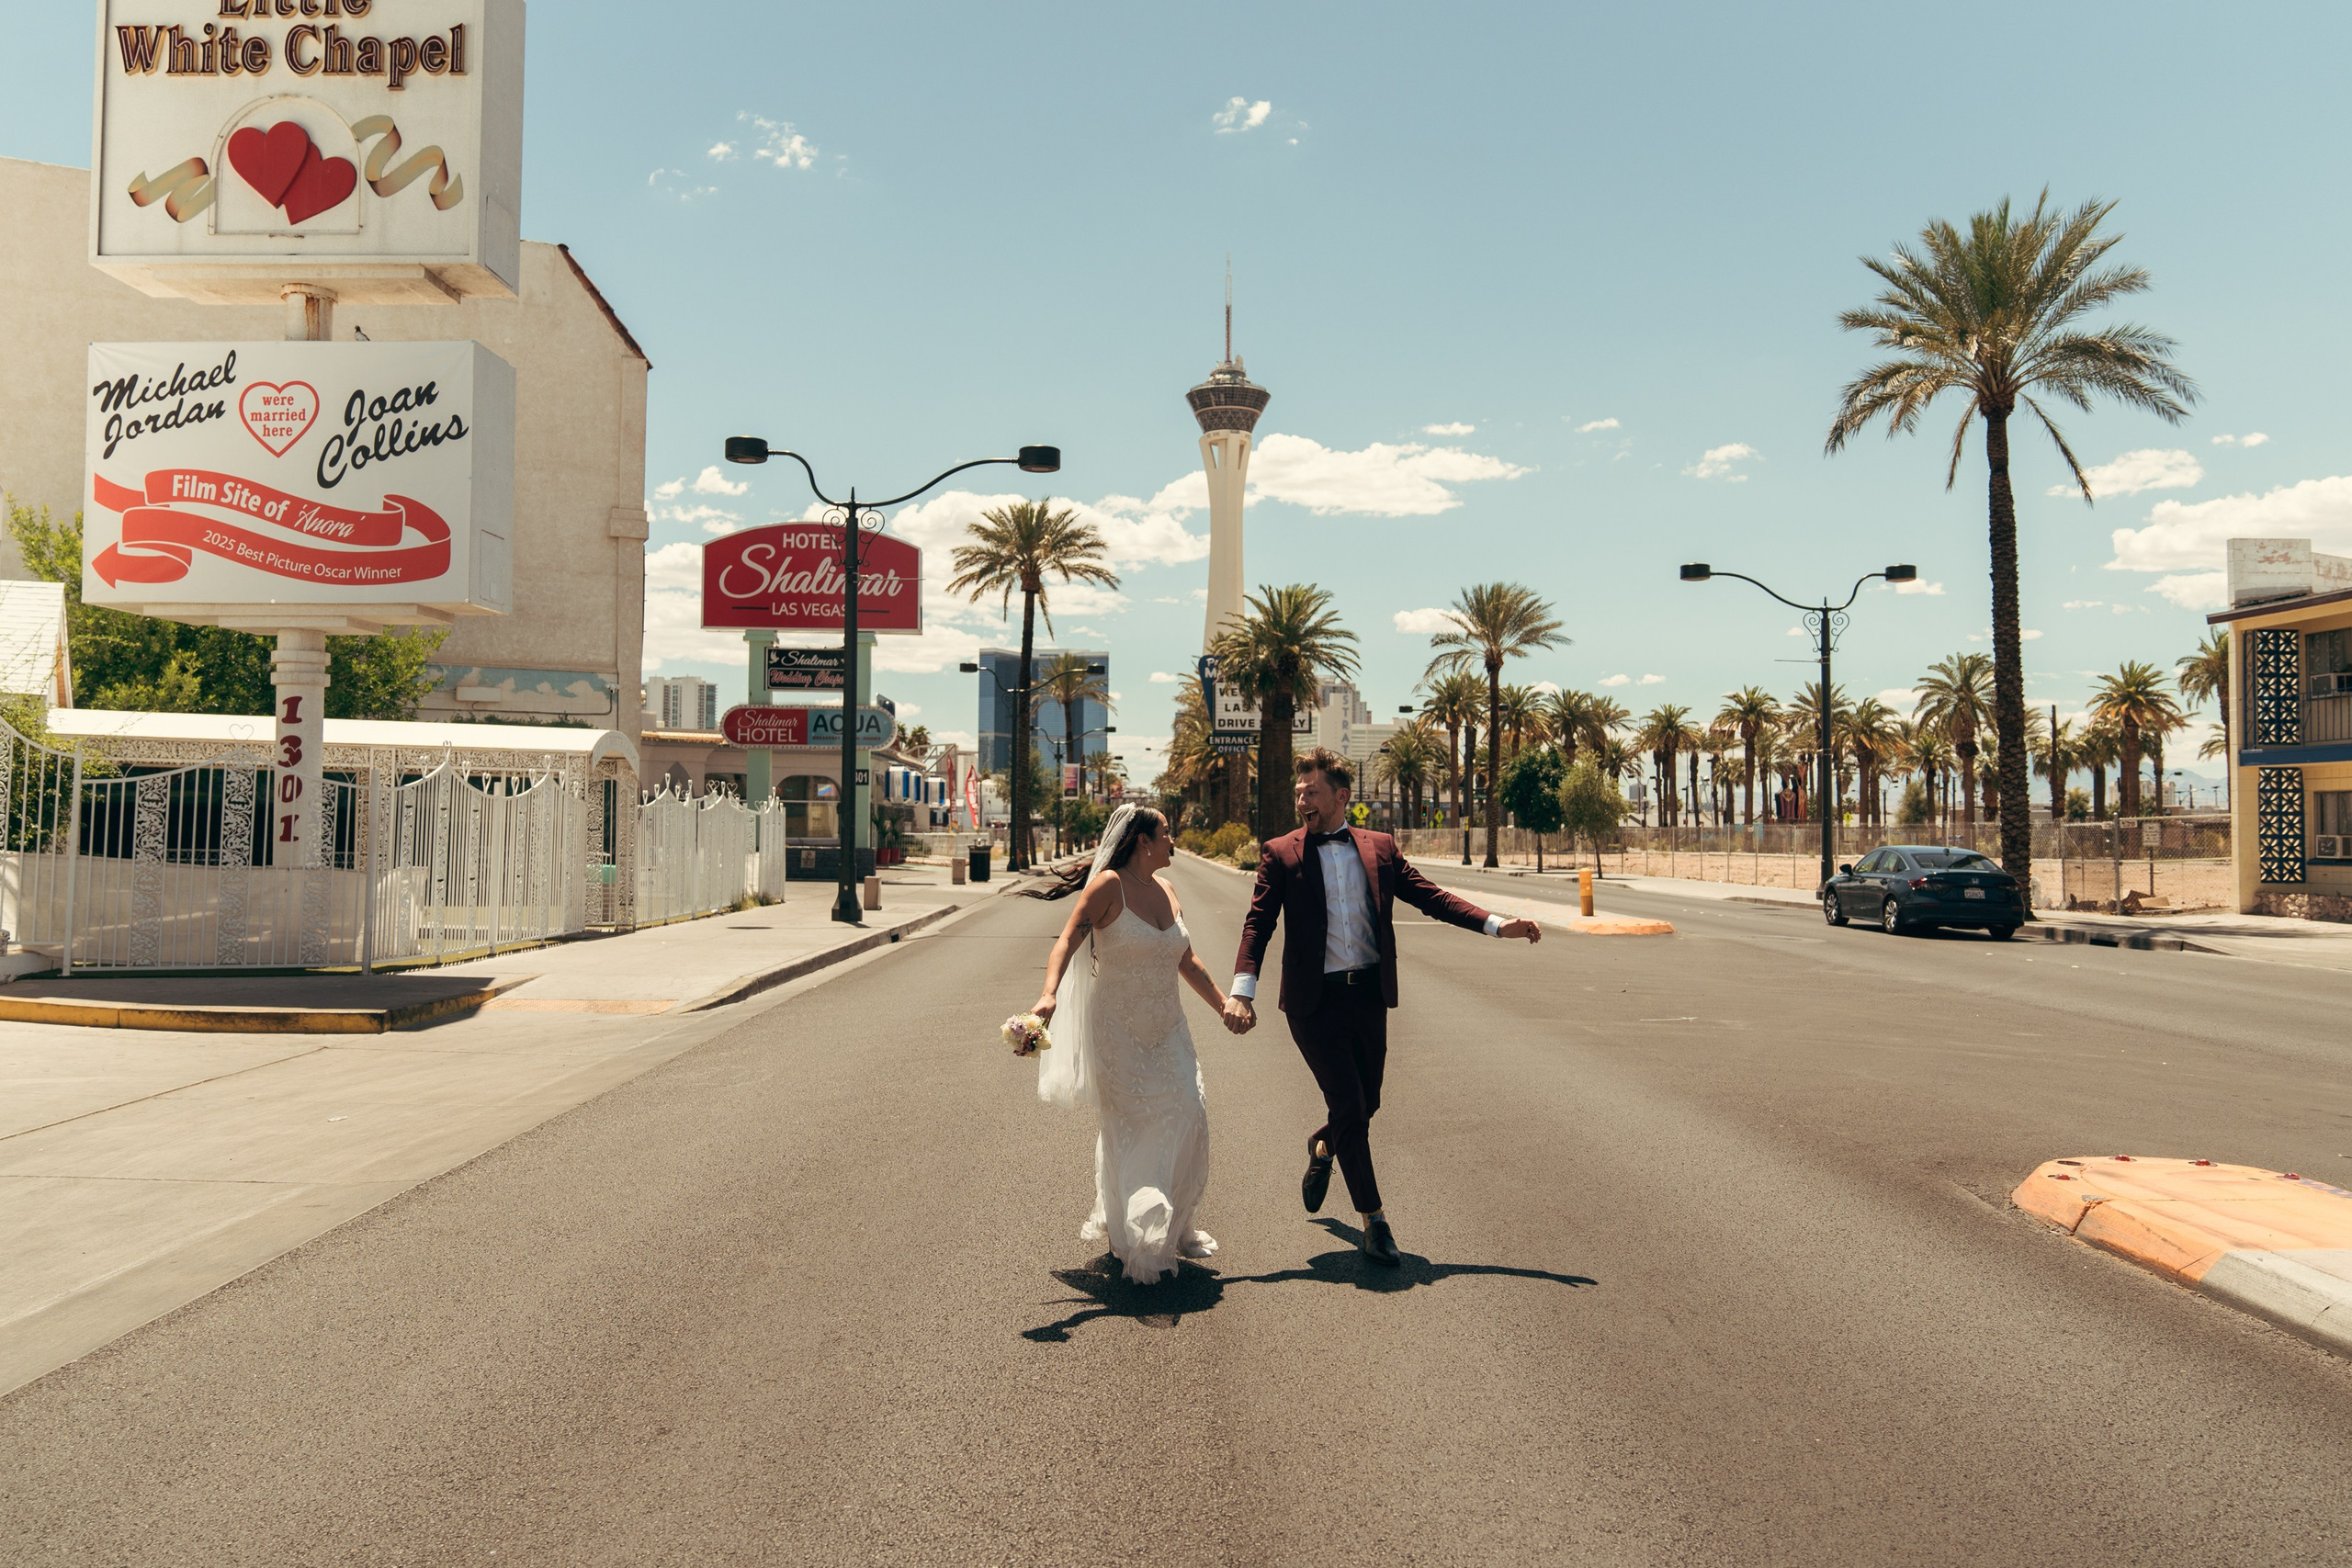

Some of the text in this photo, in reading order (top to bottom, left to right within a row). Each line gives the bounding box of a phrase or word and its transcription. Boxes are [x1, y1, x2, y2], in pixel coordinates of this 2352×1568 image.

[116, 22, 468, 92] White Chapel
[93, 349, 237, 413] Michael
[262, 393, 295, 407] were
[250, 408, 307, 423] married
[345, 380, 439, 446] Joan
[102, 396, 227, 460] Jordan
[262, 423, 293, 437] here
[317, 413, 469, 490] Collins
[172, 474, 217, 502] Film
[220, 481, 261, 513] Site
[264, 500, 291, 522] of
[783, 533, 842, 549] HOTEL
[202, 529, 401, 580] 2025 Best Picture Oscar Winner
[718, 543, 903, 599] Shalimar
[772, 603, 797, 615] LAS
[781, 650, 839, 667] Shalimar
[770, 669, 844, 688] Wedding Chape
[737, 709, 799, 728] Shalimar
[1218, 718, 1255, 728] DRIVE
[1341, 694, 1350, 755] STRAT
[737, 728, 798, 743] HOTEL
[1209, 736, 1255, 745] ENTRANCE
[1217, 745, 1246, 753] OFFICE
[277, 695, 303, 842] 1301
